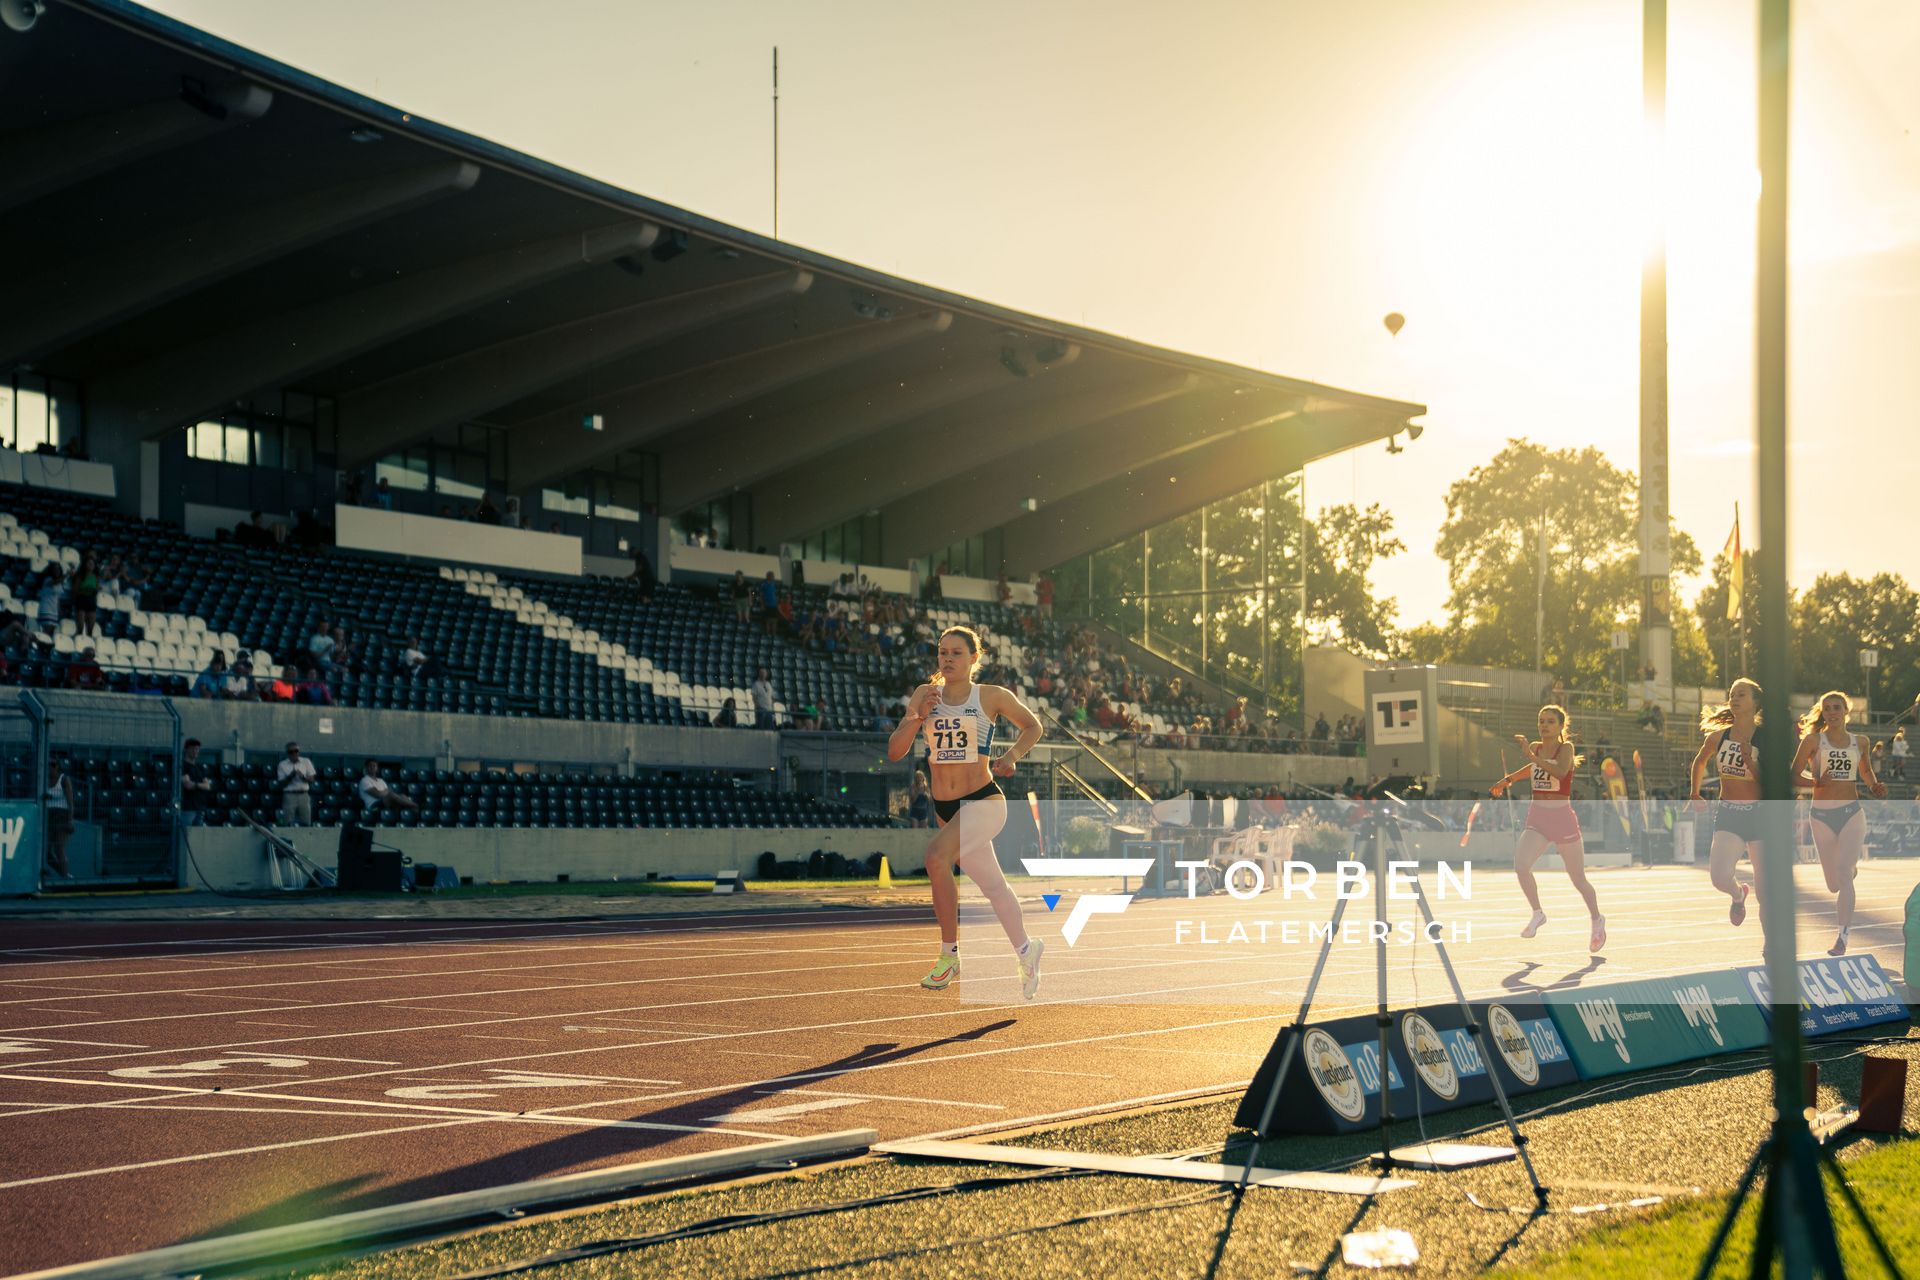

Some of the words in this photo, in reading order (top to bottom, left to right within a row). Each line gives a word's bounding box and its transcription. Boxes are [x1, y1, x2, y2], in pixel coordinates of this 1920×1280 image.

[934, 718, 961, 731] GLS
[933, 731, 968, 749] 713
[1728, 743, 1741, 753] GL
[1720, 750, 1745, 768] 119
[1828, 759, 1852, 771] 326
[1495, 1032, 1530, 1055] Warsteiner
[1530, 1021, 1563, 1062] 0,0%
[1410, 1043, 1449, 1067] Warsteiner
[1312, 1059, 1355, 1087] Warsteiner
